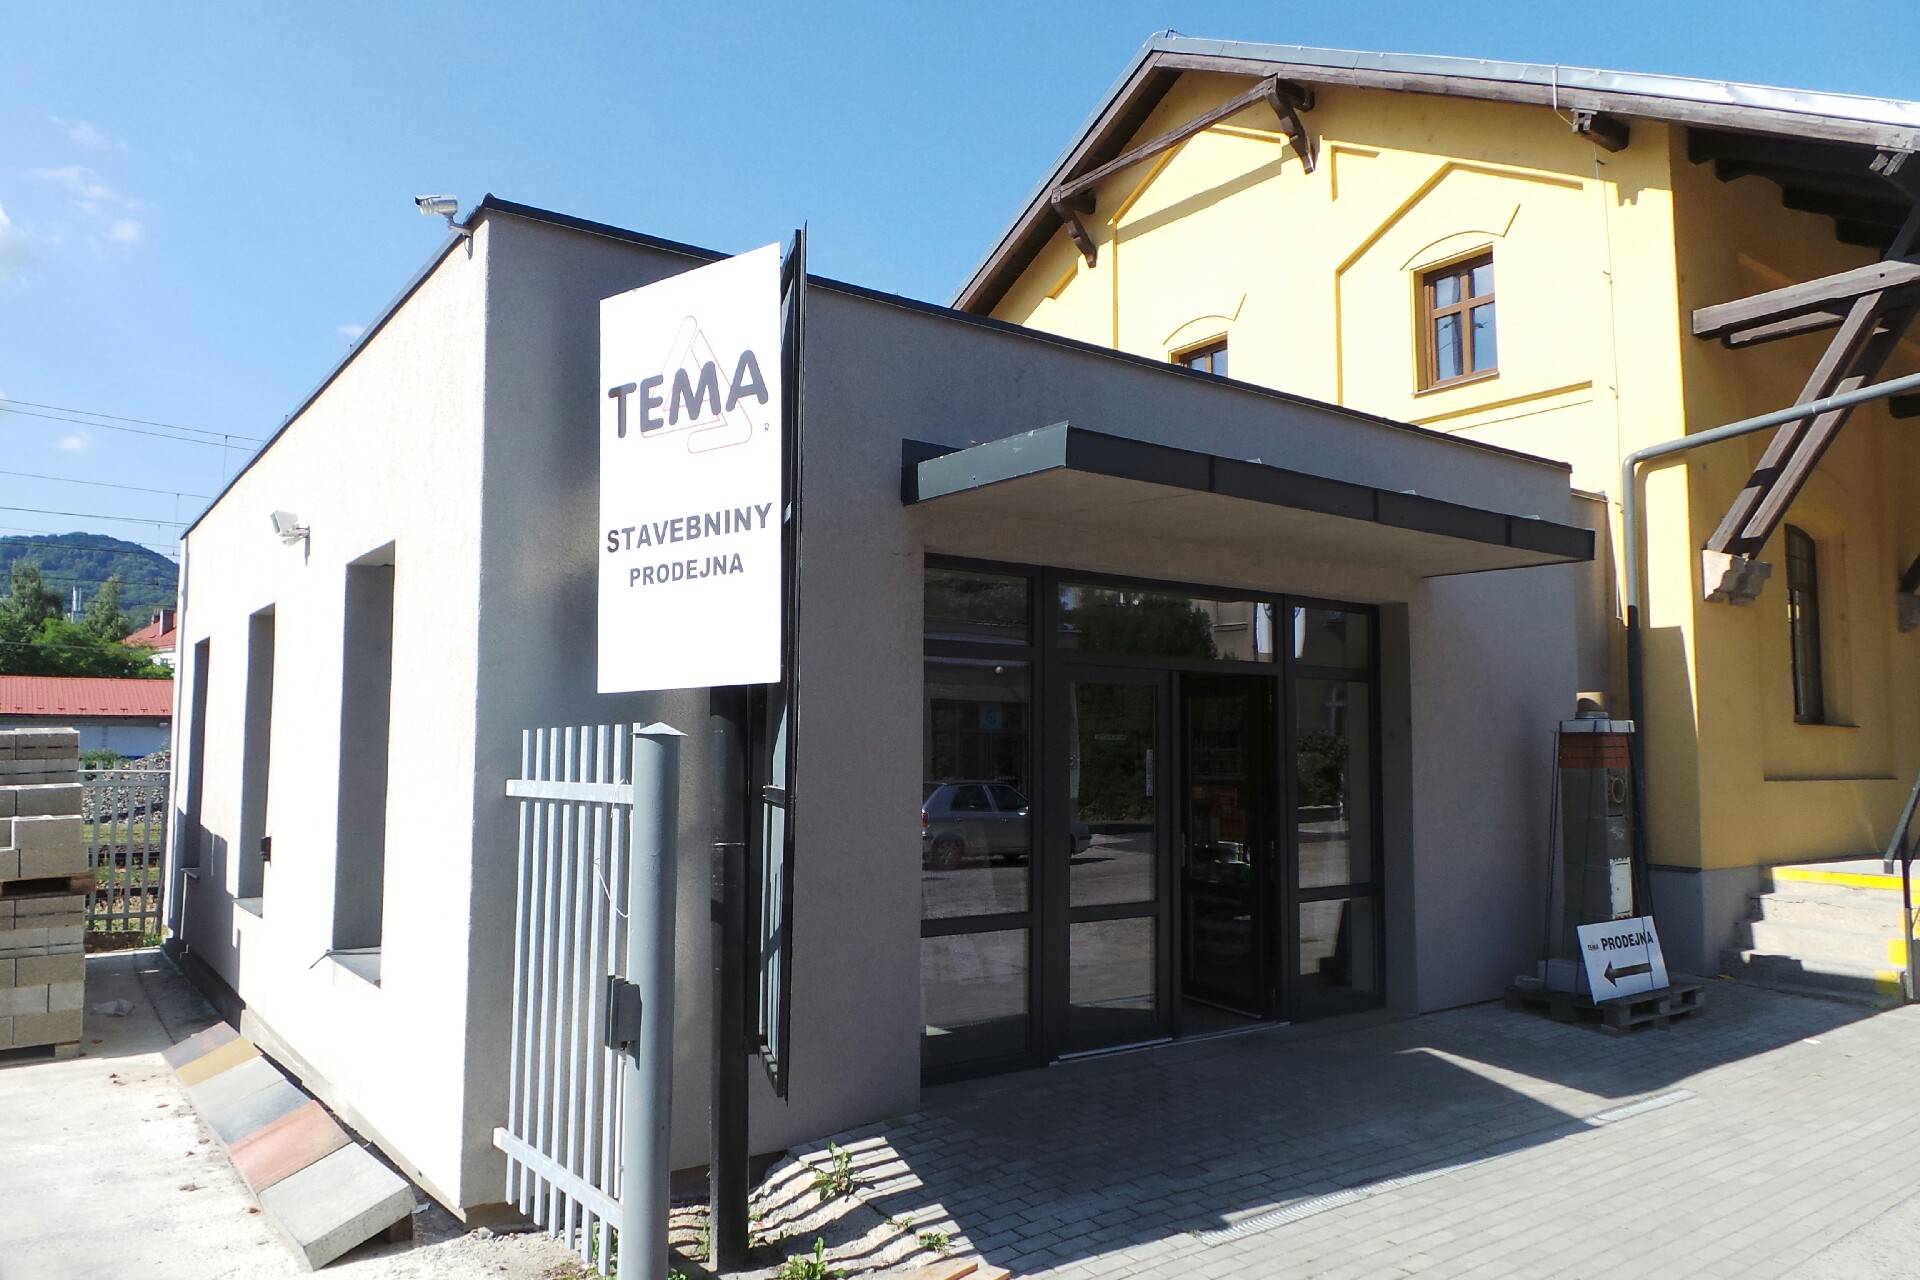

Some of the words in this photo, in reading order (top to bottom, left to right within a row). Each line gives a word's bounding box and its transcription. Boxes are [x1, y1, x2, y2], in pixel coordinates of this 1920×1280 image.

[608, 350, 769, 438] TEMA
[607, 502, 773, 553] STAVEBNINY
[629, 553, 744, 588] PRODEJNA
[1600, 931, 1654, 951] PRODEJNA
